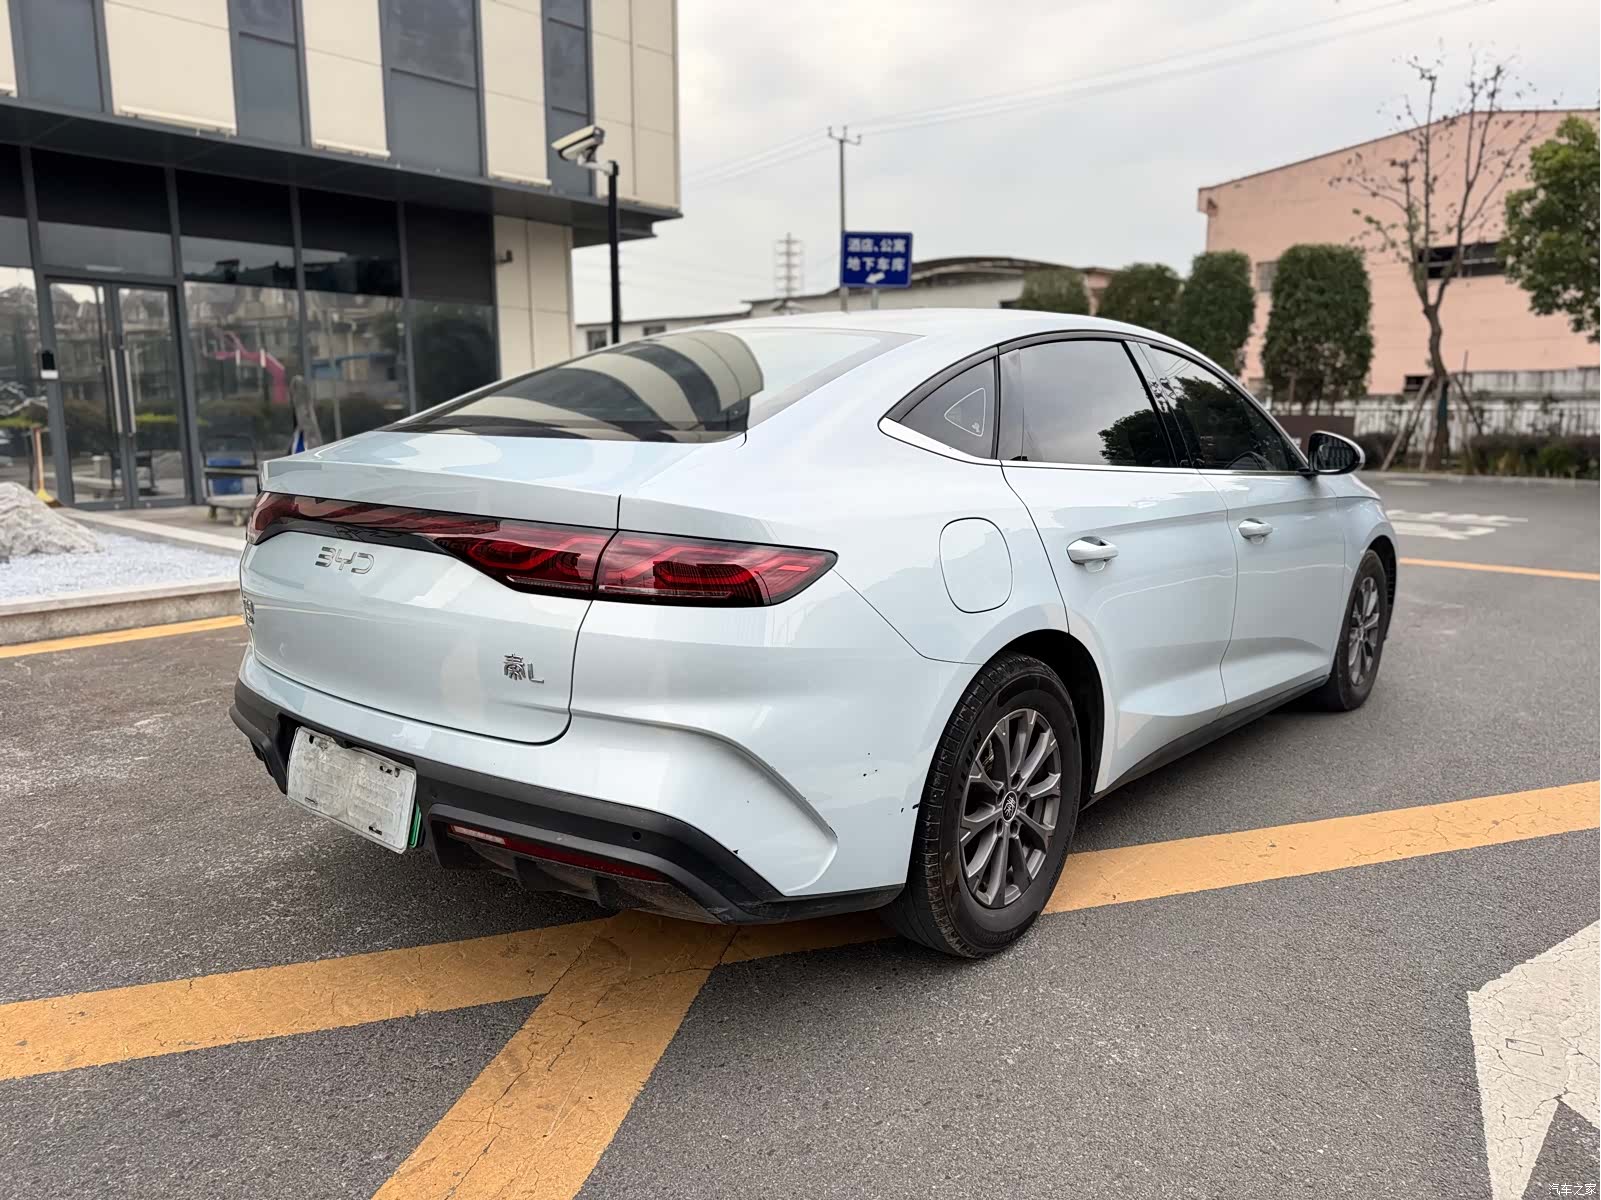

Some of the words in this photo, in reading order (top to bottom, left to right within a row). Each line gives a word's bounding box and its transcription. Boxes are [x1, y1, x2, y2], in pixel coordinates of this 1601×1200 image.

[847, 256, 906, 271] 地下车库
[315, 546, 375, 575] BYD
